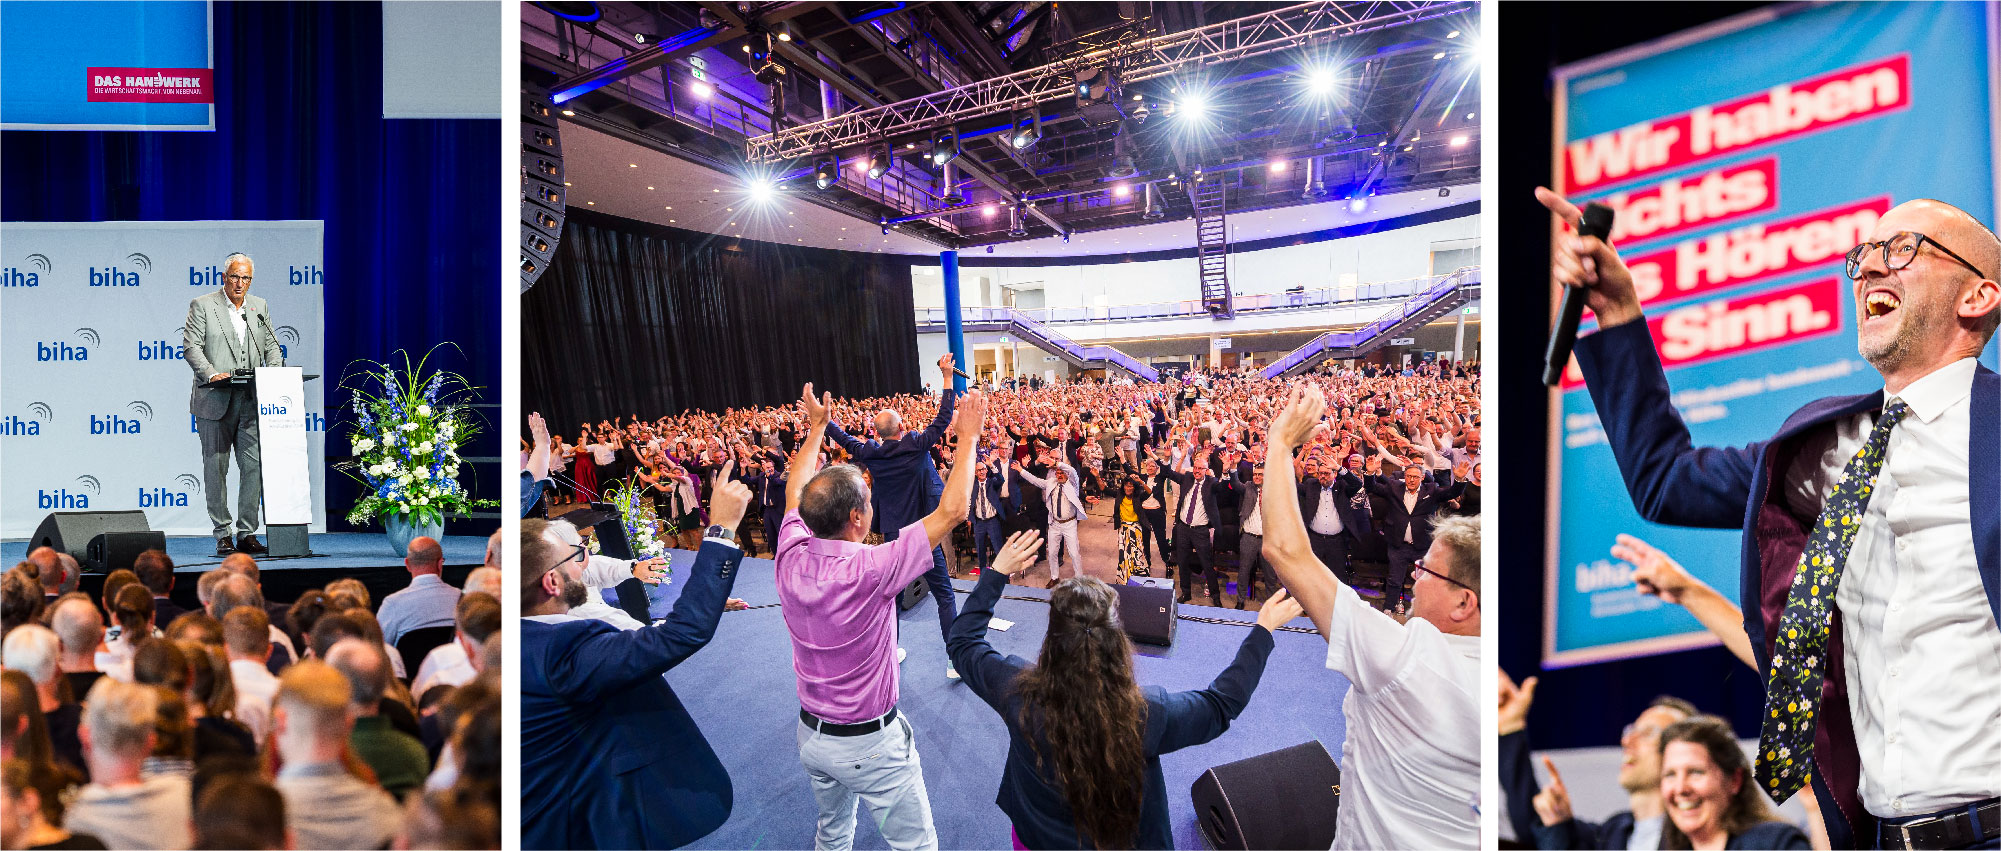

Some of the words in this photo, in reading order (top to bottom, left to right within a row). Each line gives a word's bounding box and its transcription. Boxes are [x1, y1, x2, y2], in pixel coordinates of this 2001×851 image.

[94, 75, 122, 87] DAS
[126, 72, 201, 88] HANDWERK
[1569, 121, 1681, 186] Wir
[1690, 67, 1900, 155] haben
[1607, 169, 1769, 241] ichts
[1675, 208, 1880, 291] Hören
[0, 267, 39, 287] iha
[89, 267, 140, 287] biha
[189, 265, 225, 286] bih
[289, 265, 324, 286] bih
[1661, 294, 1831, 361] Sinn.
[37, 341, 88, 361] biha
[138, 340, 185, 361] biha
[260, 403, 287, 416] biha
[0, 415, 40, 436] iha
[90, 414, 141, 434] biha
[38, 488, 89, 509] biha
[138, 487, 188, 508] biha
